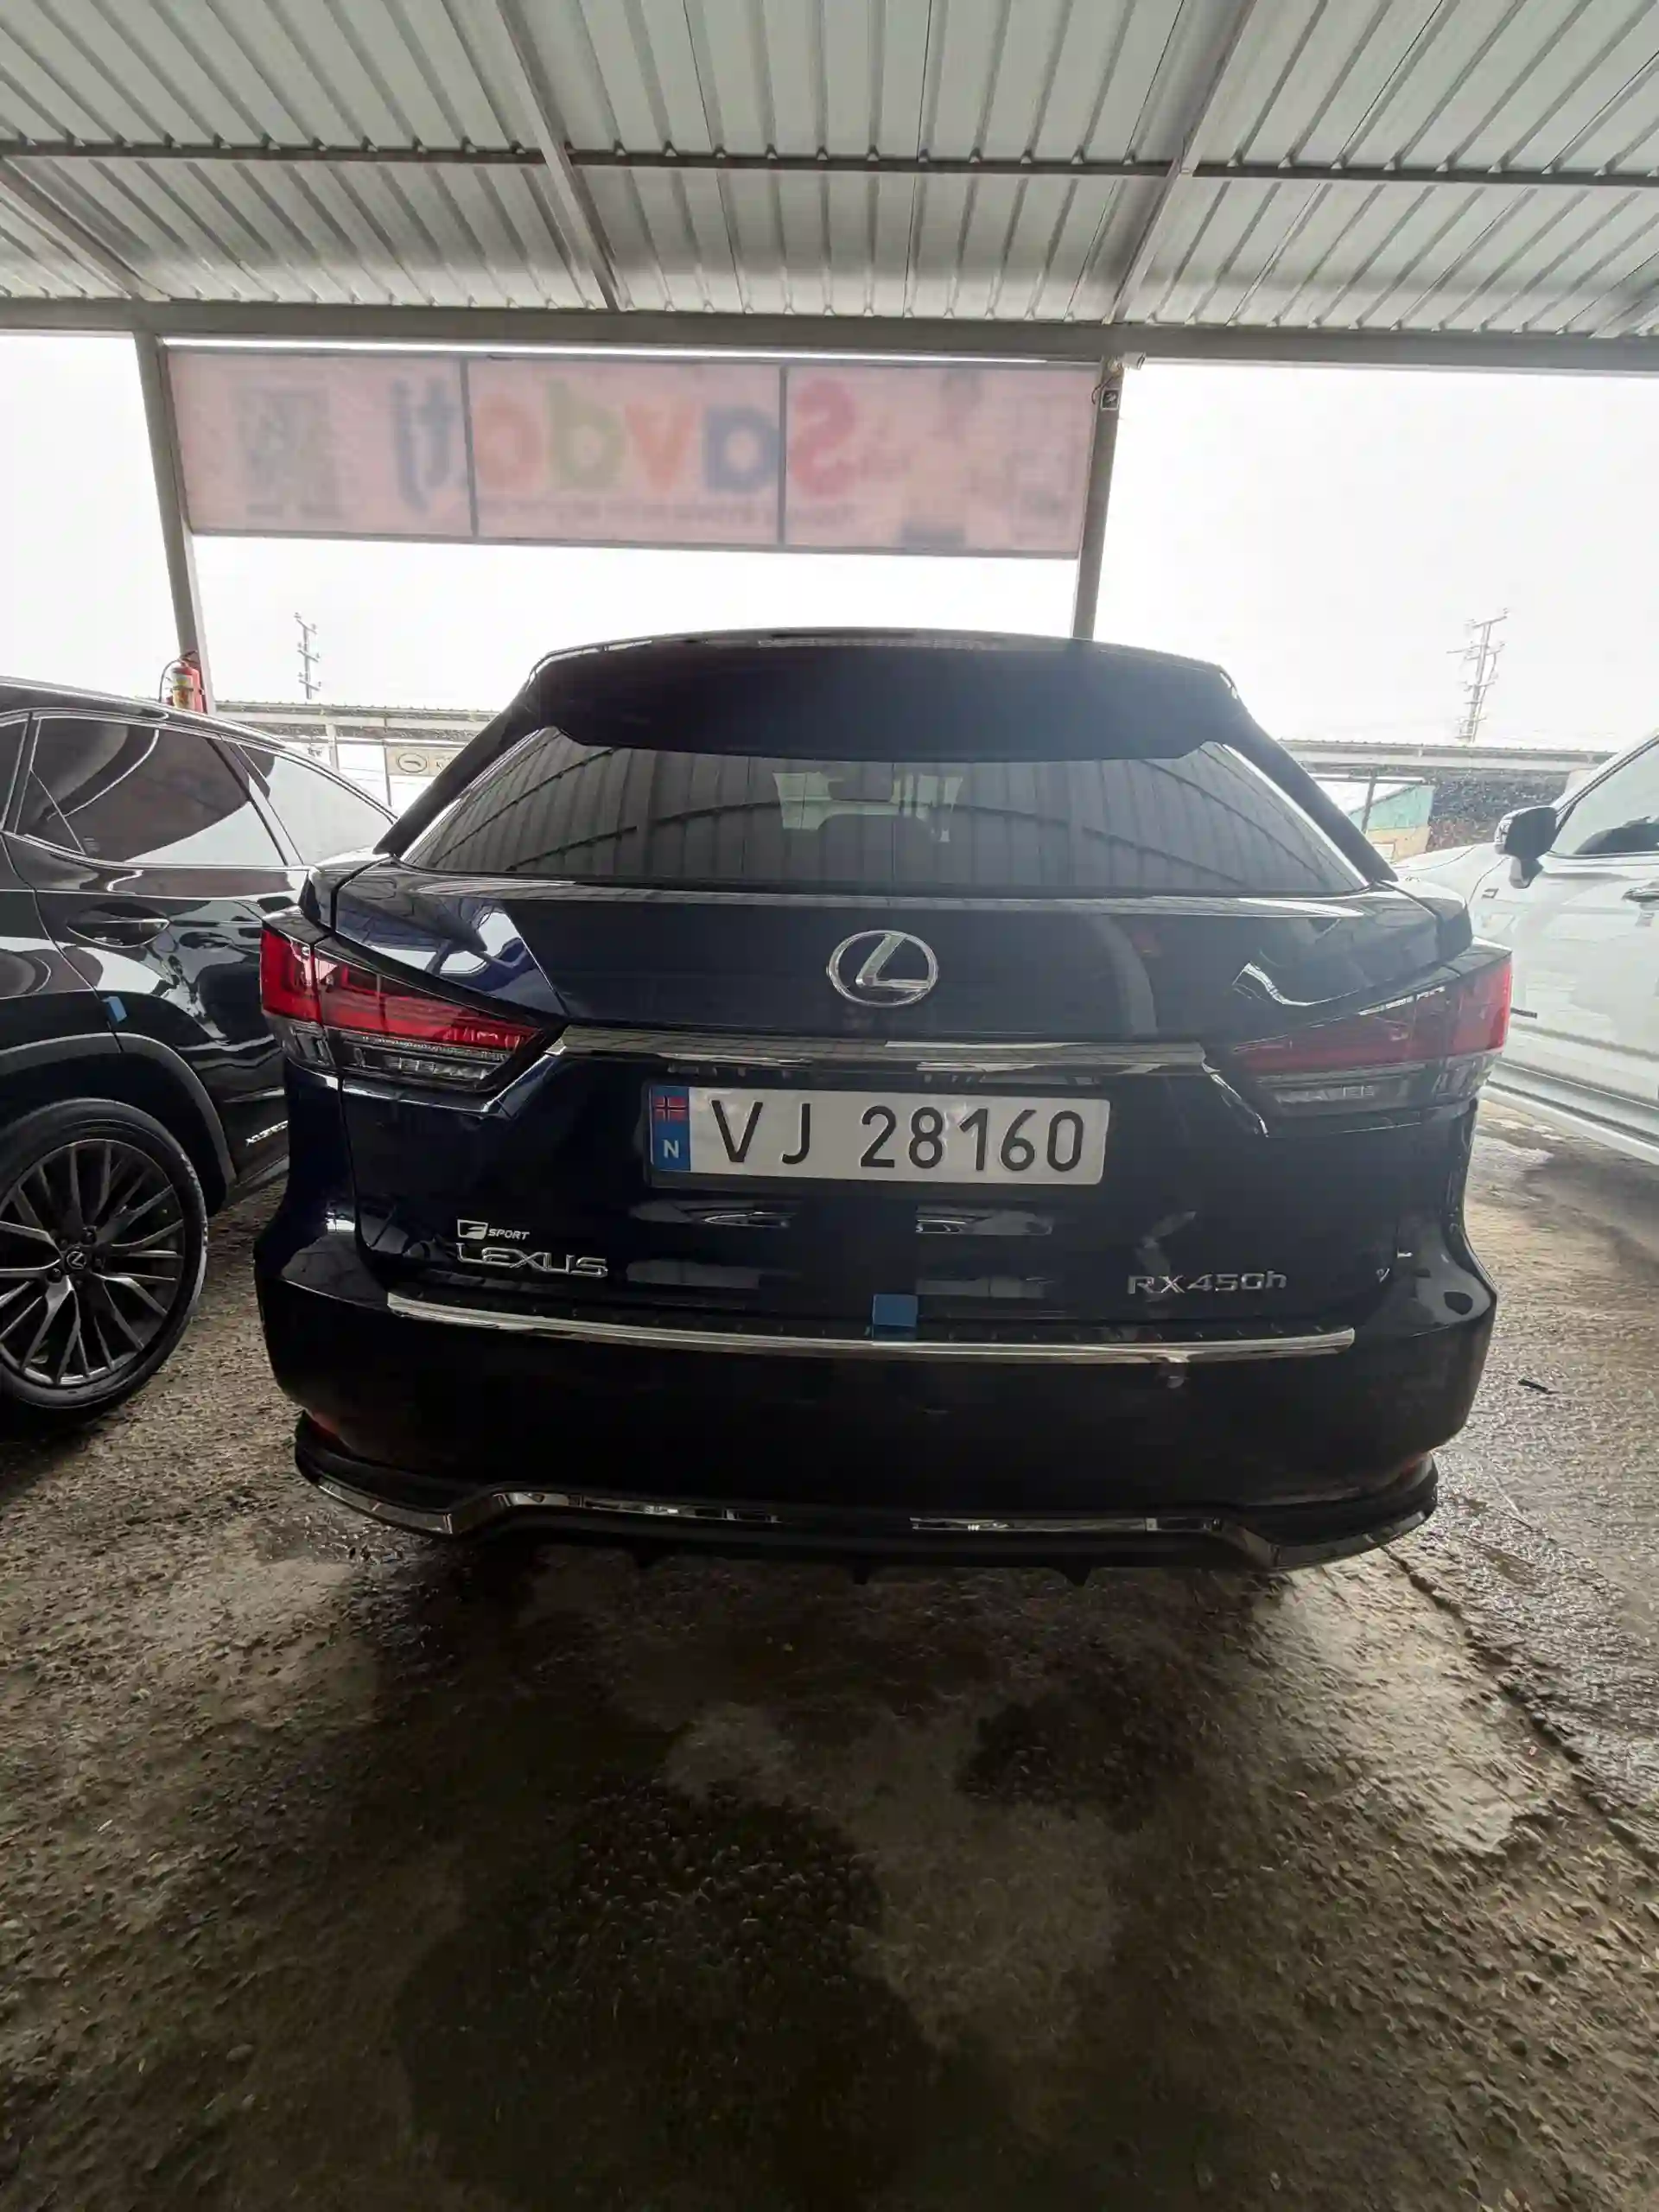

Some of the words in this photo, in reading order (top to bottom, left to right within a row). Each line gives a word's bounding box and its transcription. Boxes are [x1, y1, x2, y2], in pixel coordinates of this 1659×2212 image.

[663, 1139, 682, 1159] N
[859, 1104, 1085, 1173] 28160
[486, 1227, 530, 1241] SPORT
[455, 1243, 609, 1278] LEXUS
